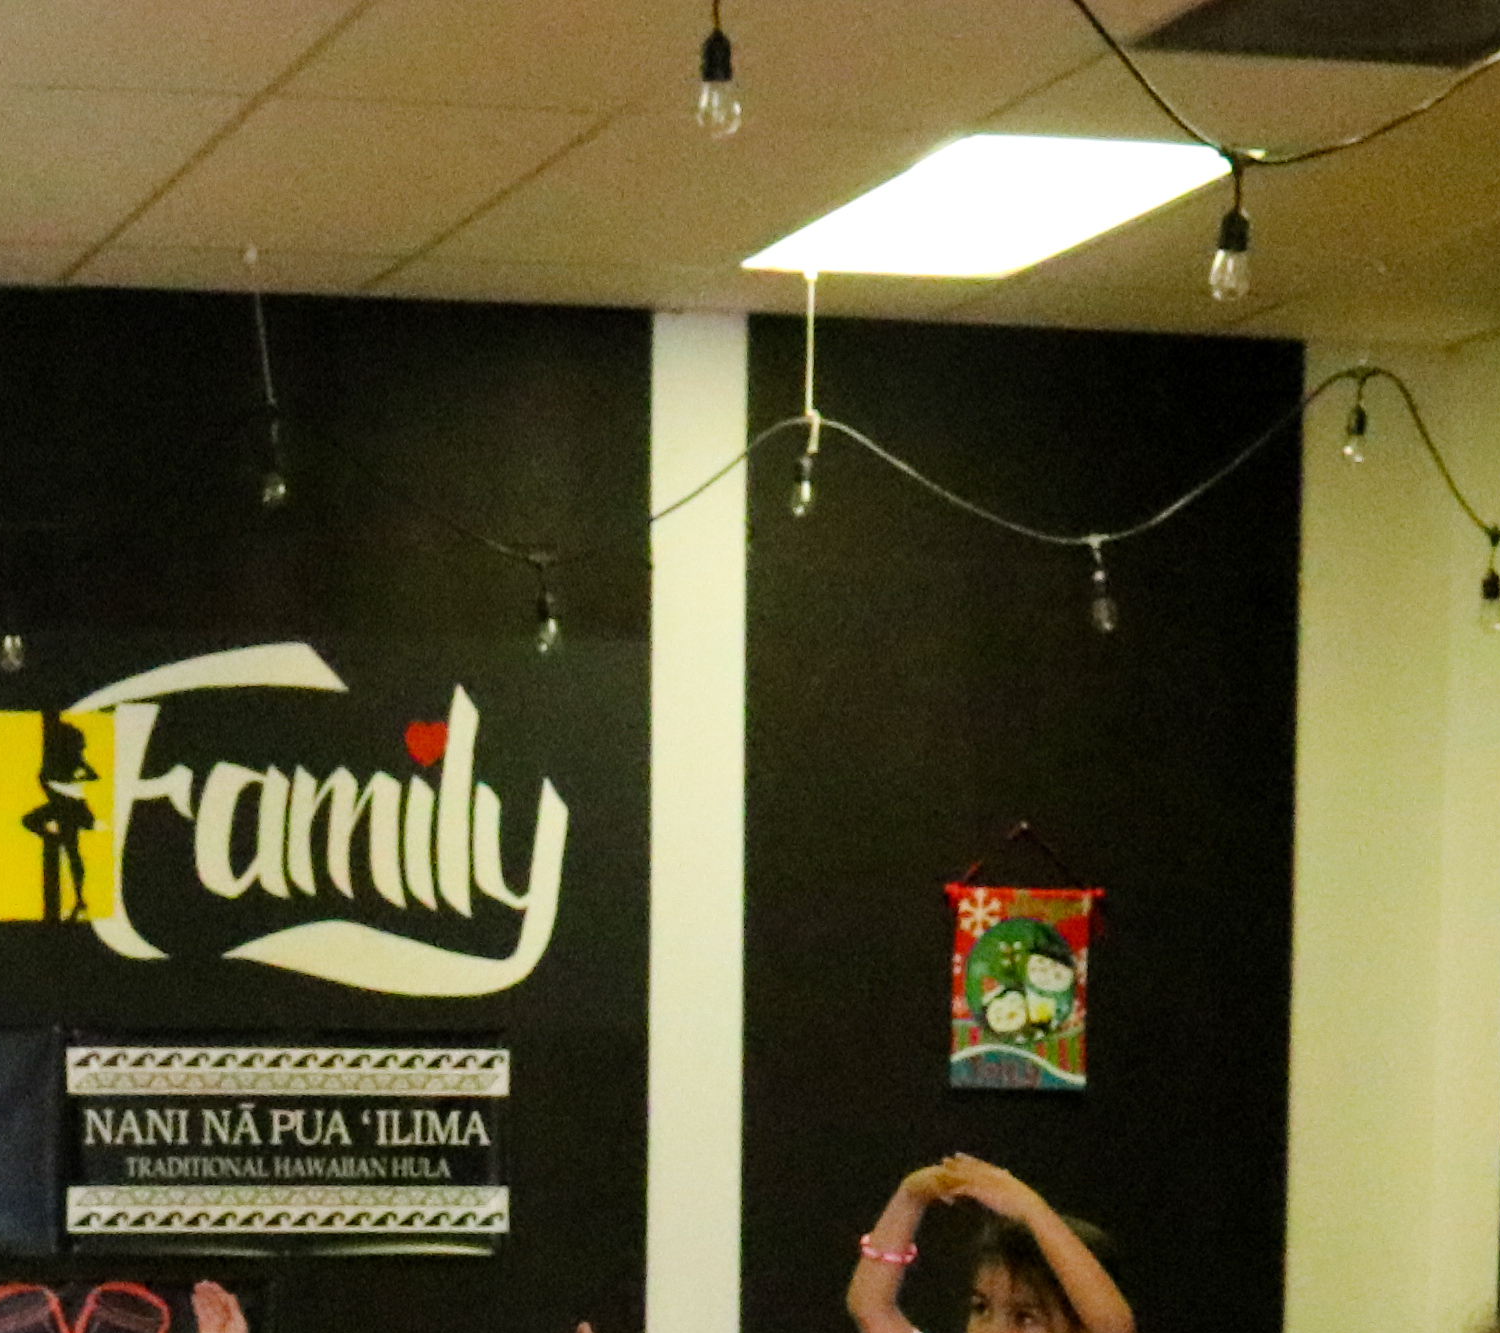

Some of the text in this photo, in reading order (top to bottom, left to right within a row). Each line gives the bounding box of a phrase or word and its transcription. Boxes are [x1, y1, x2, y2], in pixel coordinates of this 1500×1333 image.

[66, 642, 568, 997] Family
[84, 1108, 190, 1146] NANI
[202, 1102, 263, 1146] NĀ
[269, 1109, 352, 1146] PUA
[126, 1156, 452, 1179] TRADITIONAL HAWAIIAN HULA
